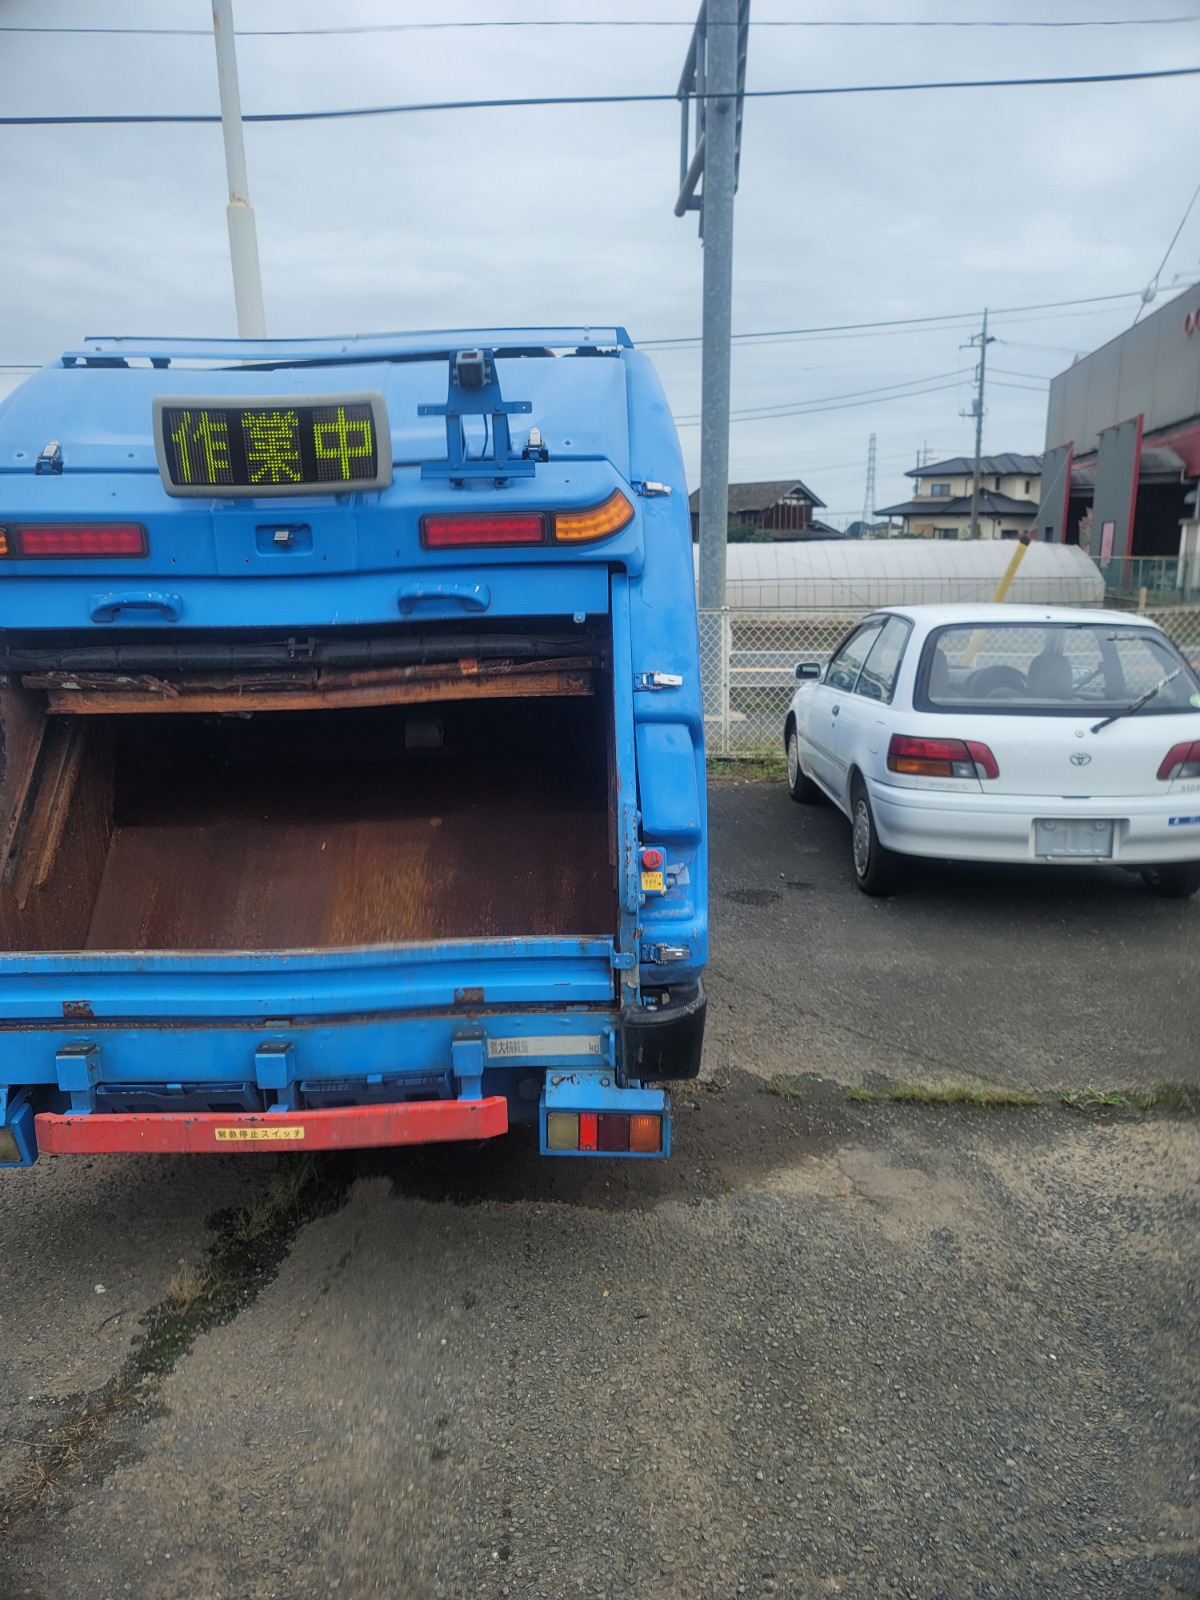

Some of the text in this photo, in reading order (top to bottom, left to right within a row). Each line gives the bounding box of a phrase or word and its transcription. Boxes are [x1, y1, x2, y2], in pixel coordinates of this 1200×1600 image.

[172, 407, 373, 483] 作業中
[588, 1042, 600, 1054] kg
[217, 1129, 302, 1139] 緊急停止スイッチ
